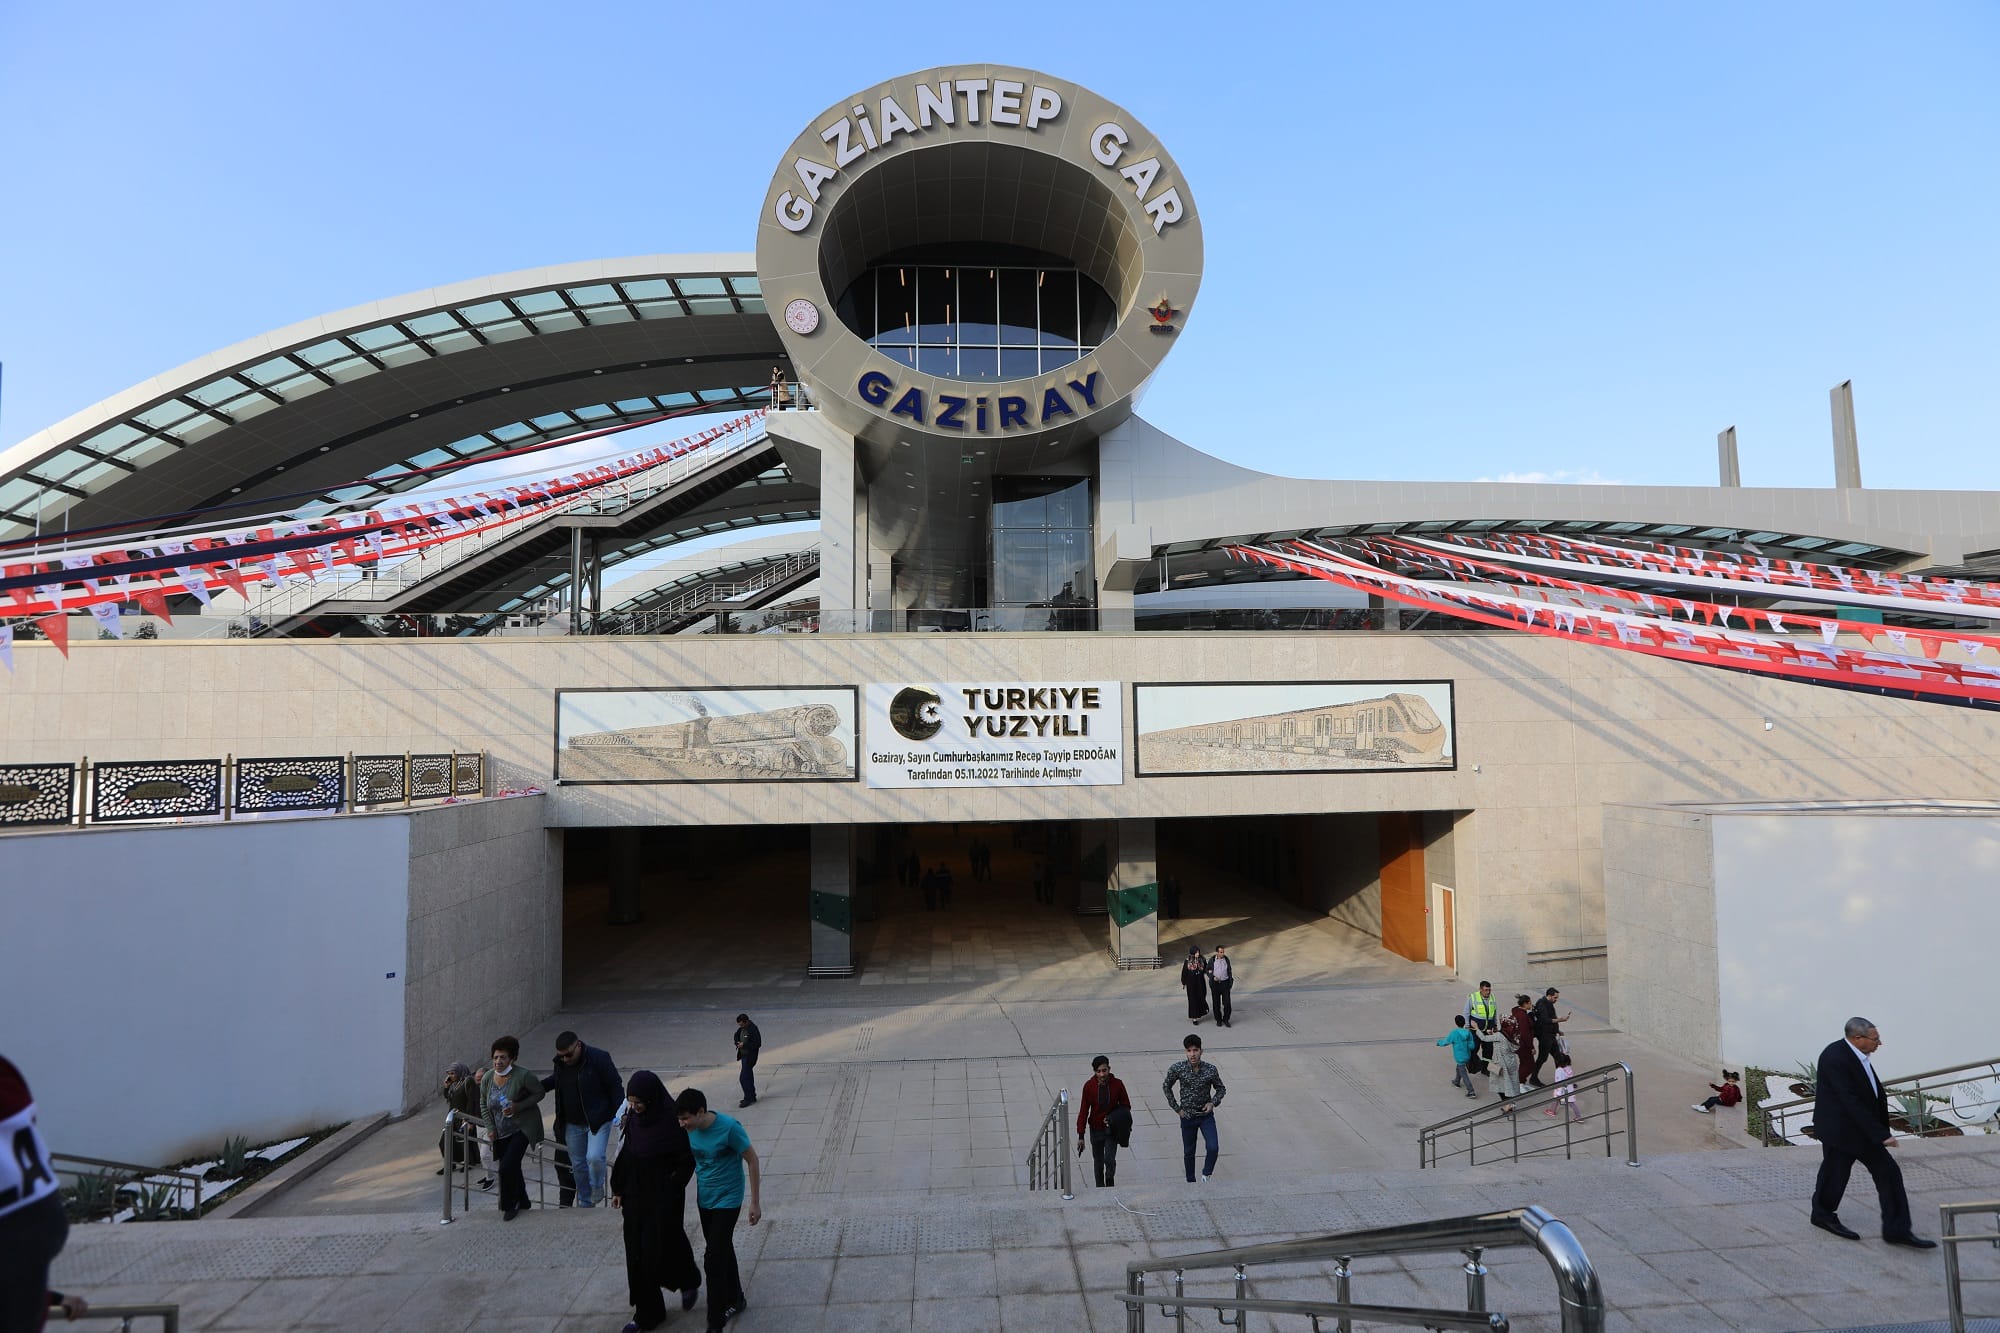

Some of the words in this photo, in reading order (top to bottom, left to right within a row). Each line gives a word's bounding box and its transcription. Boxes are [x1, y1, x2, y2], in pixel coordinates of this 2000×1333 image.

[1090, 122, 1184, 234] GAR
[962, 687, 1100, 710] TÜRKİYE
[963, 714, 1088, 738] YÜZYILI
[871, 752, 906, 765] Gaziray,
[907, 751, 931, 765] Sayın
[932, 750, 1014, 764] Cumhurbaşkanımız
[1015, 750, 1042, 763] Recep
[1043, 749, 1071, 763] Tayyip
[1073, 746, 1117, 761] ERDOĞAN
[907, 768, 953, 780] Tarafından
[954, 768, 999, 780] 05.11.2022
[1001, 767, 1040, 779] Tarihinde
[1042, 766, 1083, 780] Açılmıştır
